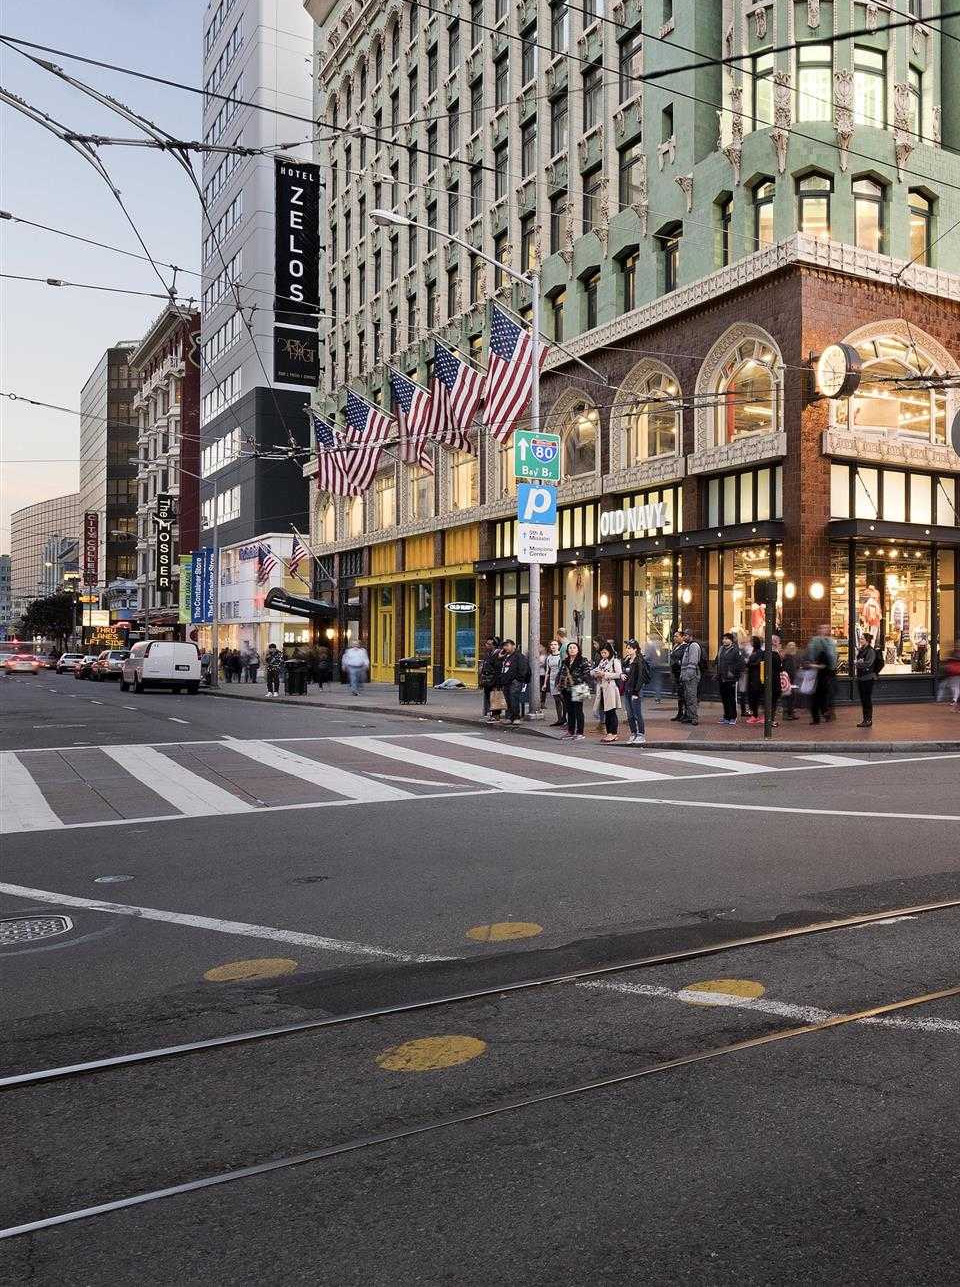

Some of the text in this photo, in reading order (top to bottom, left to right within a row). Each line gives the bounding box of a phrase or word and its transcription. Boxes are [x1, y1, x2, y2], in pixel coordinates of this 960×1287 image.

[280, 166, 314, 182] HOTEL
[289, 186, 304, 302] ZELOS
[536, 446, 554, 459] 80
[522, 465, 538, 477] Bay
[159, 499, 171, 518] The
[600, 502, 664, 536] OLD NAVY
[156, 517, 172, 587] MOSSER
[193, 557, 202, 575] Store
[193, 575, 202, 607] Container
[91, 632, 118, 640] LANES
[95, 626, 116, 634] THRU
